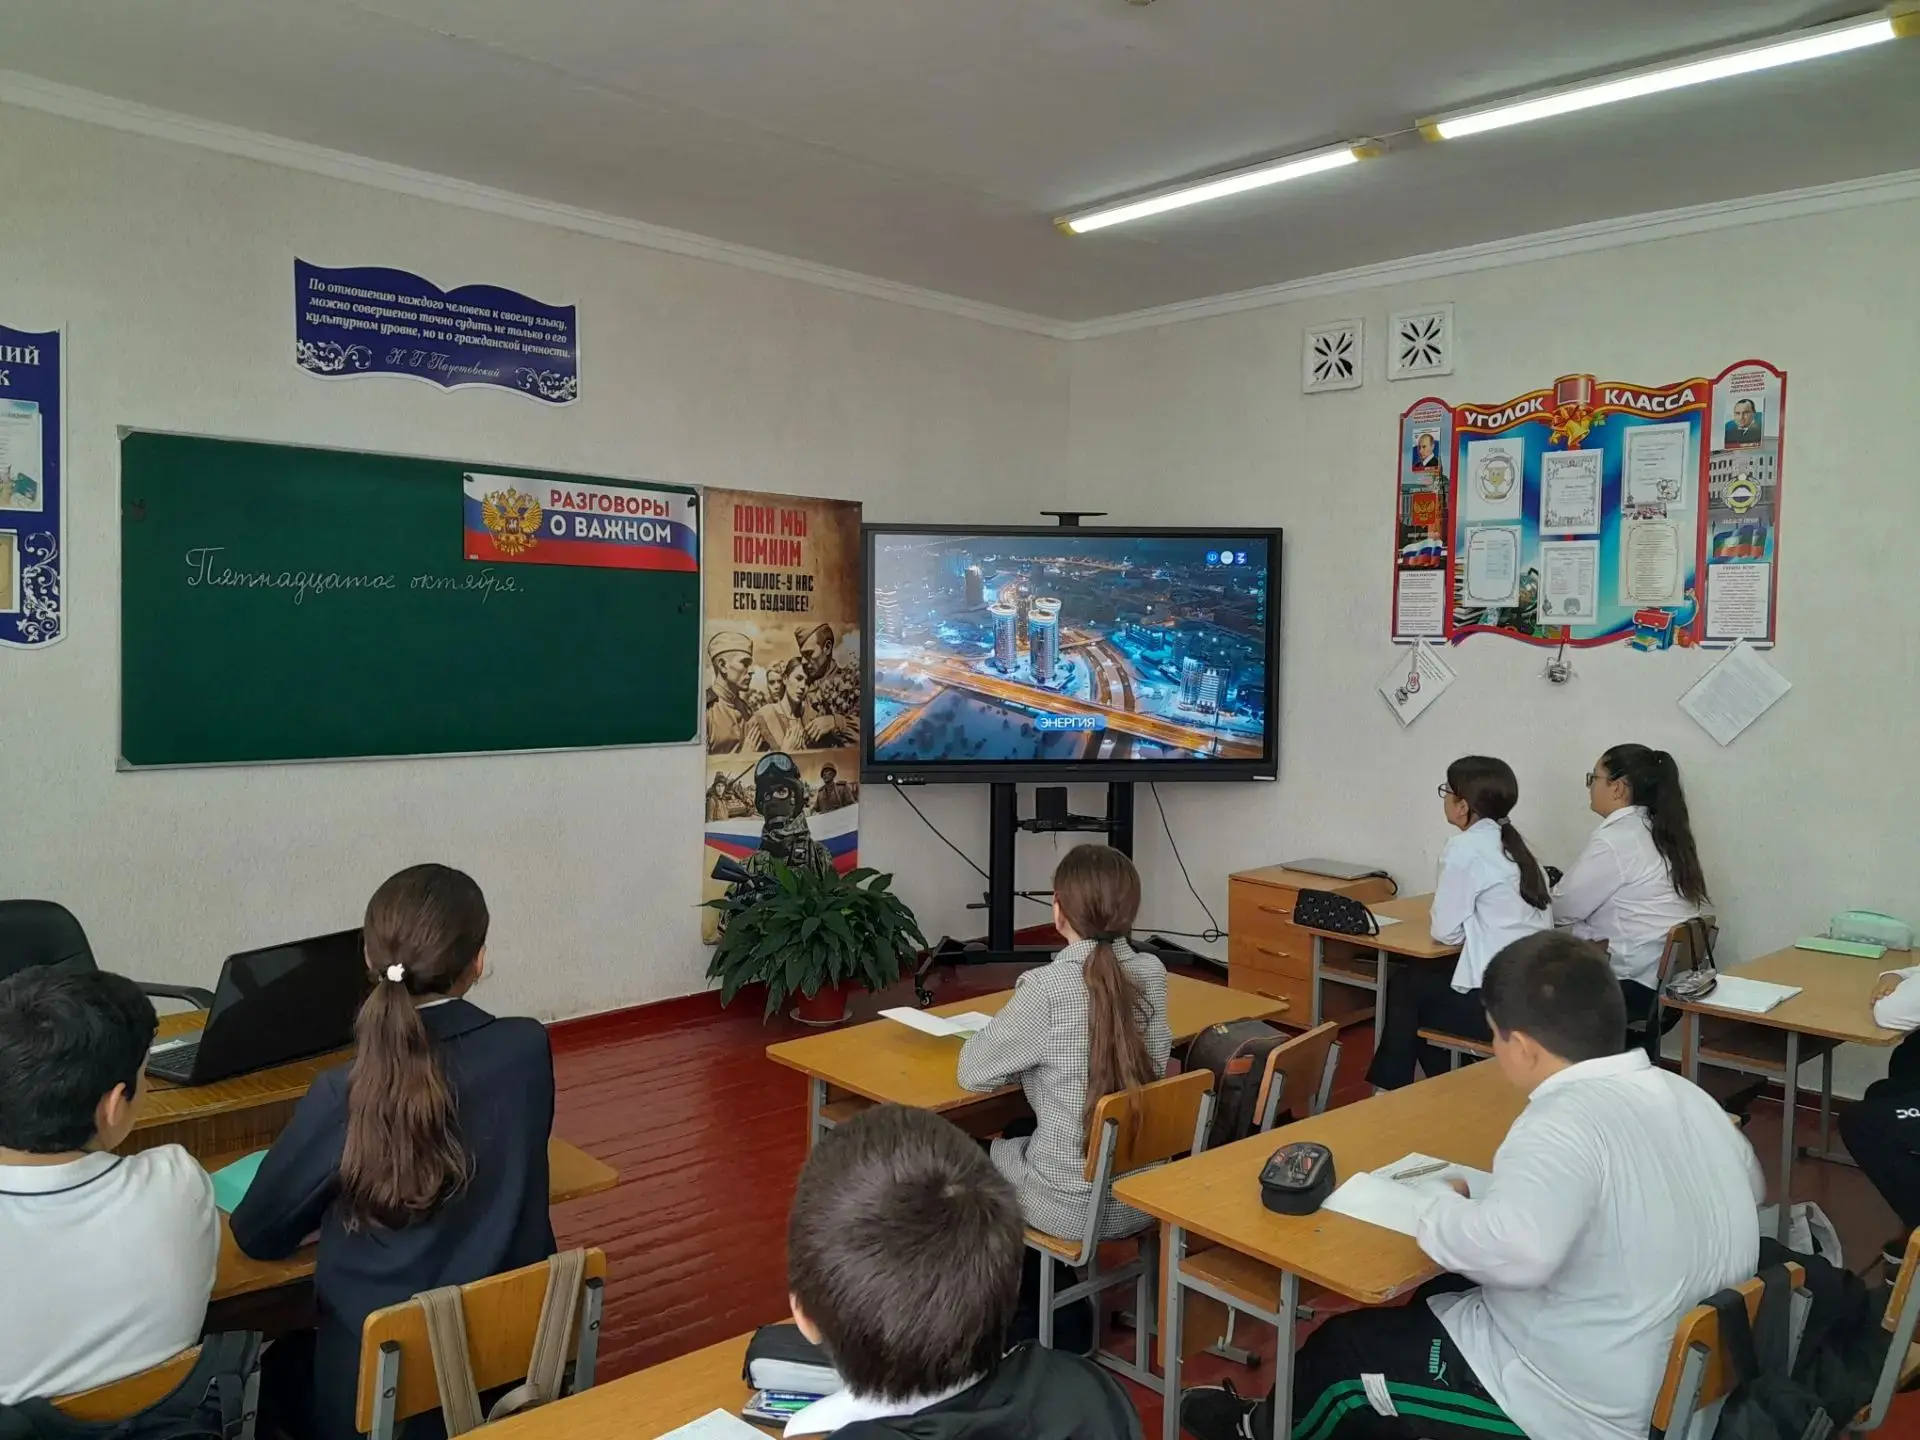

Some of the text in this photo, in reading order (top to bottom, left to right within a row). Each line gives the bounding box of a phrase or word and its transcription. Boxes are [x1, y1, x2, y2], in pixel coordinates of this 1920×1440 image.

[308, 277, 567, 331] По отношению каждого человека к своему языку,
[309, 297, 567, 343] можно совершенно точно судить не только о его
[305, 312, 570, 358] культурном уровне, но и о гражданской ценности.
[426, 351, 501, 378] Паустовский
[1463, 396, 1545, 428] УГОЛОК
[1605, 387, 1696, 413] КЛАССА
[550, 489, 670, 518] РАЗГОВОРЫ
[550, 514, 672, 544] О ВАЖНОМ
[733, 504, 807, 537] ПОКА МЫ
[733, 535, 802, 567] ПОМНИМ
[185, 546, 525, 605] Пятнадцатое октября.
[795, 574, 814, 592] НАС
[733, 592, 809, 613] ЕСТЬ БУДУЩЕЕ!
[1040, 716, 1096, 729] ЭНЕРГИЯ
[1428, 1338, 1441, 1374] PUMA
